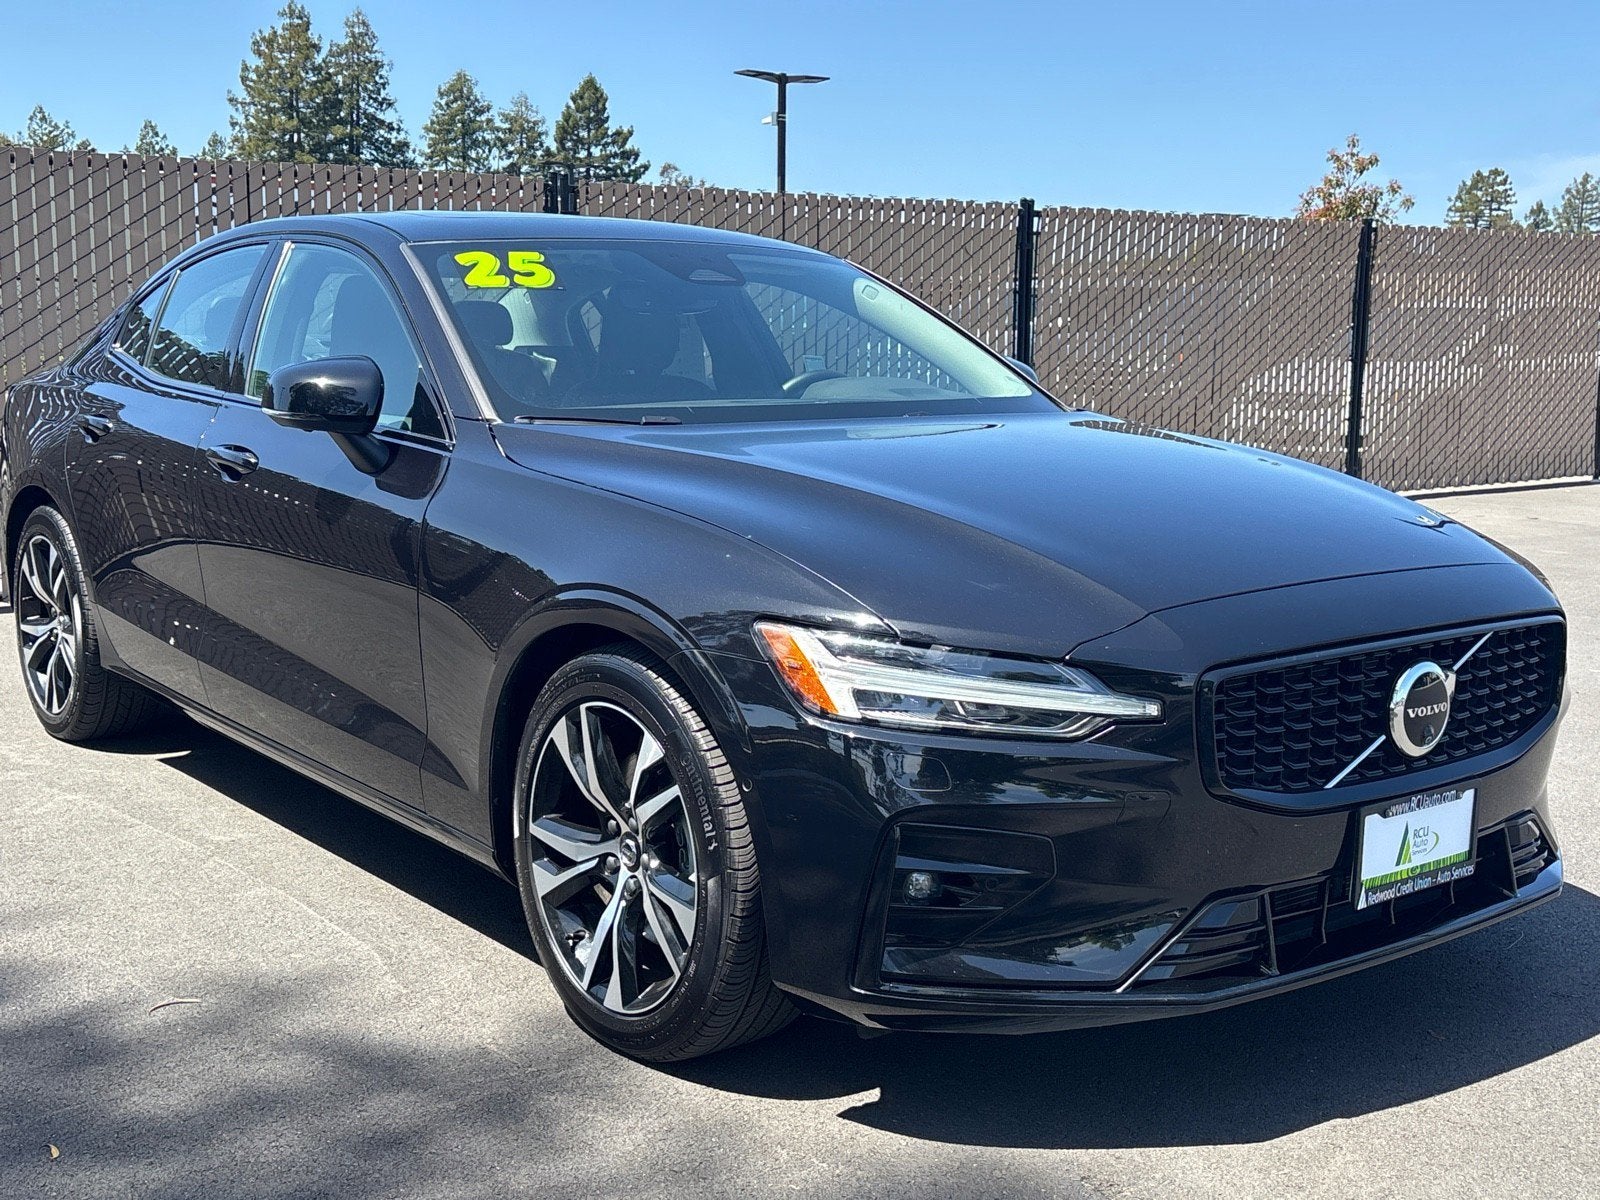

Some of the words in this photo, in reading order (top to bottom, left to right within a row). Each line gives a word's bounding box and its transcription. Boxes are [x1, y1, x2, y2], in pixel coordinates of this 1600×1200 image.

[454, 251, 555, 288] 25
[1407, 702, 1447, 718] VOLVO
[1413, 826, 1430, 840] RCU
[1412, 838, 1429, 848] Auto
[1367, 884, 1396, 905] Redwood
[1396, 879, 1414, 896] Credit
[1414, 875, 1432, 890] Union
[1436, 871, 1451, 884] Auto
[1451, 863, 1475, 880] Services
